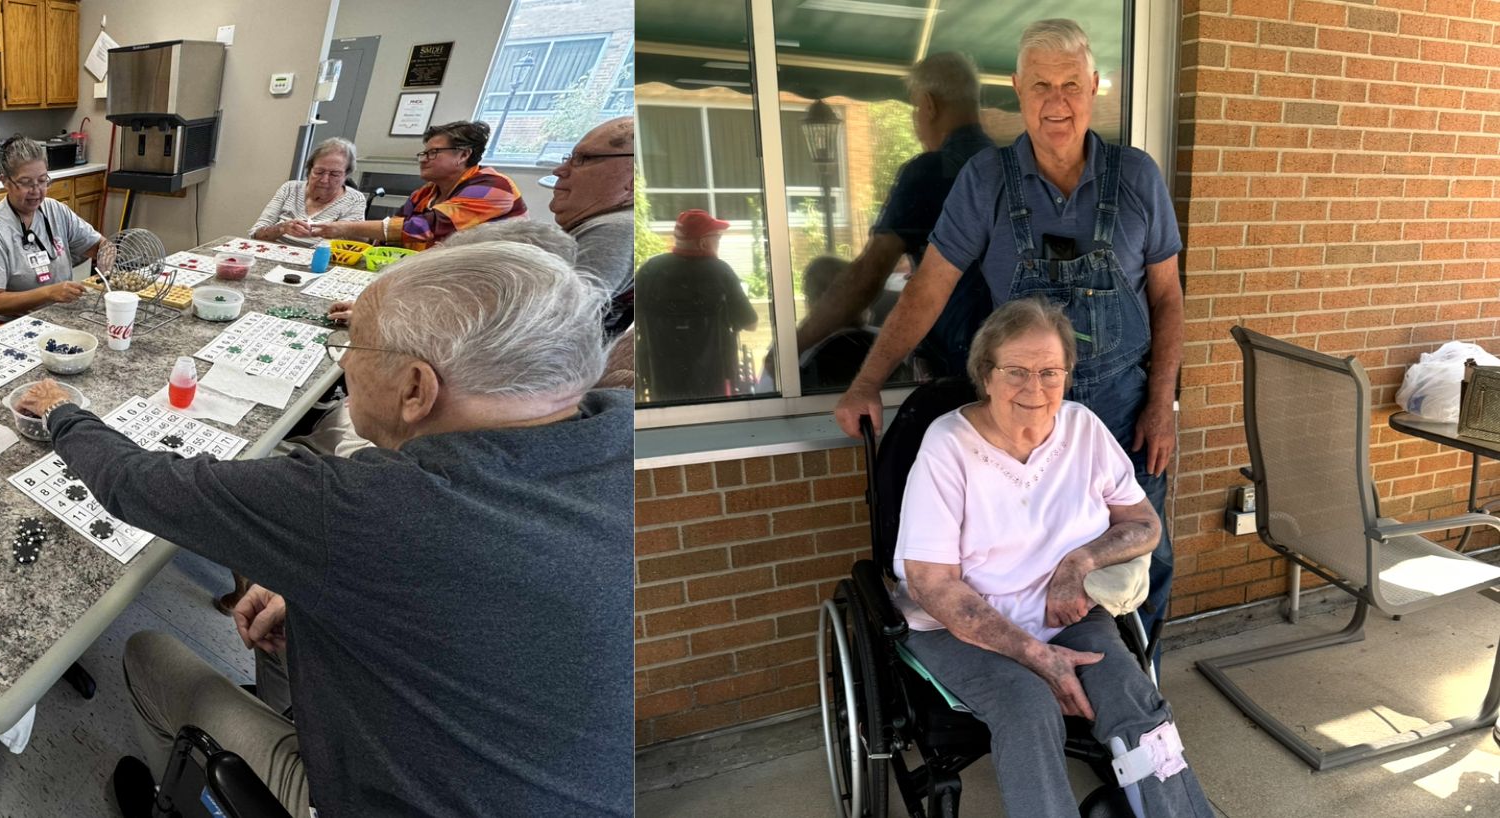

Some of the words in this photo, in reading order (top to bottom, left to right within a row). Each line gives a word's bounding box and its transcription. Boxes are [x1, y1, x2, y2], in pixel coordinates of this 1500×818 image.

[132, 422, 143, 430] 31
[142, 414, 153, 422] 56
[152, 408, 162, 416] 67
[138, 438, 149, 446] 22
[167, 414, 180, 422] 62
[193, 437, 206, 446] 55
[203, 428, 215, 437] 61
[212, 444, 224, 454] 57
[221, 436, 234, 444] 71
[53, 478, 66, 488] 19
[73, 510, 86, 521] 11
[112, 538, 122, 547] 7
